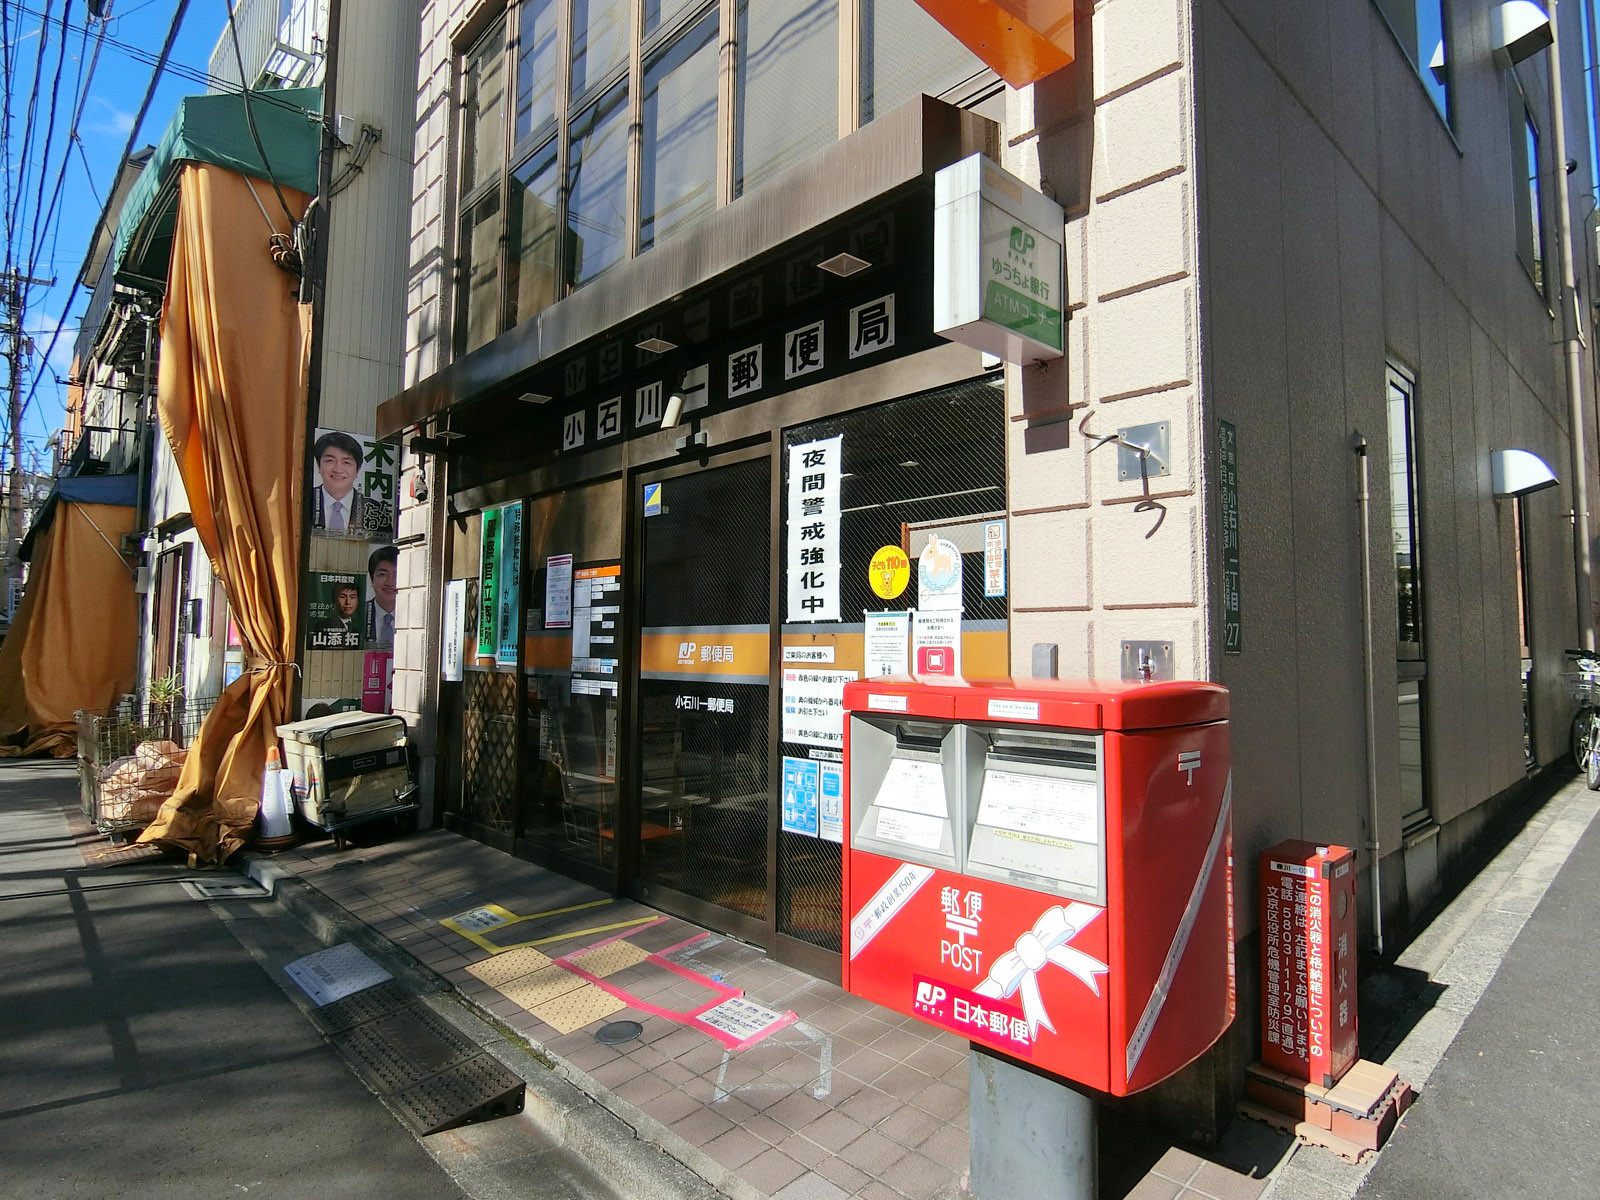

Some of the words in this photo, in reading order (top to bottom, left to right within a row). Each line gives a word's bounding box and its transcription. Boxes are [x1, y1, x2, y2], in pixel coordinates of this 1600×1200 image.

[1007, 250, 1034, 270] BANK
[991, 257, 1050, 301] ゆうちょ銀行
[994, 291, 1055, 326] ATMコーナー
[564, 302, 890, 448] 小石川一郵便局
[363, 441, 394, 500] 木内
[800, 448, 827, 614] 夜間警戒強化中
[320, 574, 355, 584] 日本共産党
[989, 568, 1000, 589] 禁止
[1226, 623, 1240, 646] 27
[700, 645, 734, 663] 郵便局
[675, 694, 734, 714] 小石川一郵便局
[873, 870, 917, 920] 郵政創業150年
[941, 885, 983, 922] 郵便
[1280, 876, 1294, 902] 電話
[941, 940, 983, 975] POST
[1266, 886, 1280, 1044] 文京区役所危機管理室防災課
[1294, 879, 1310, 1063] ご連絡は、左記までお願いします。
[1309, 881, 1323, 1058] この消火器と格納箱についての
[1337, 935, 1349, 1027] 消火器
[915, 1001, 944, 1017] POST
[953, 997, 1030, 1046] 日本郵便
